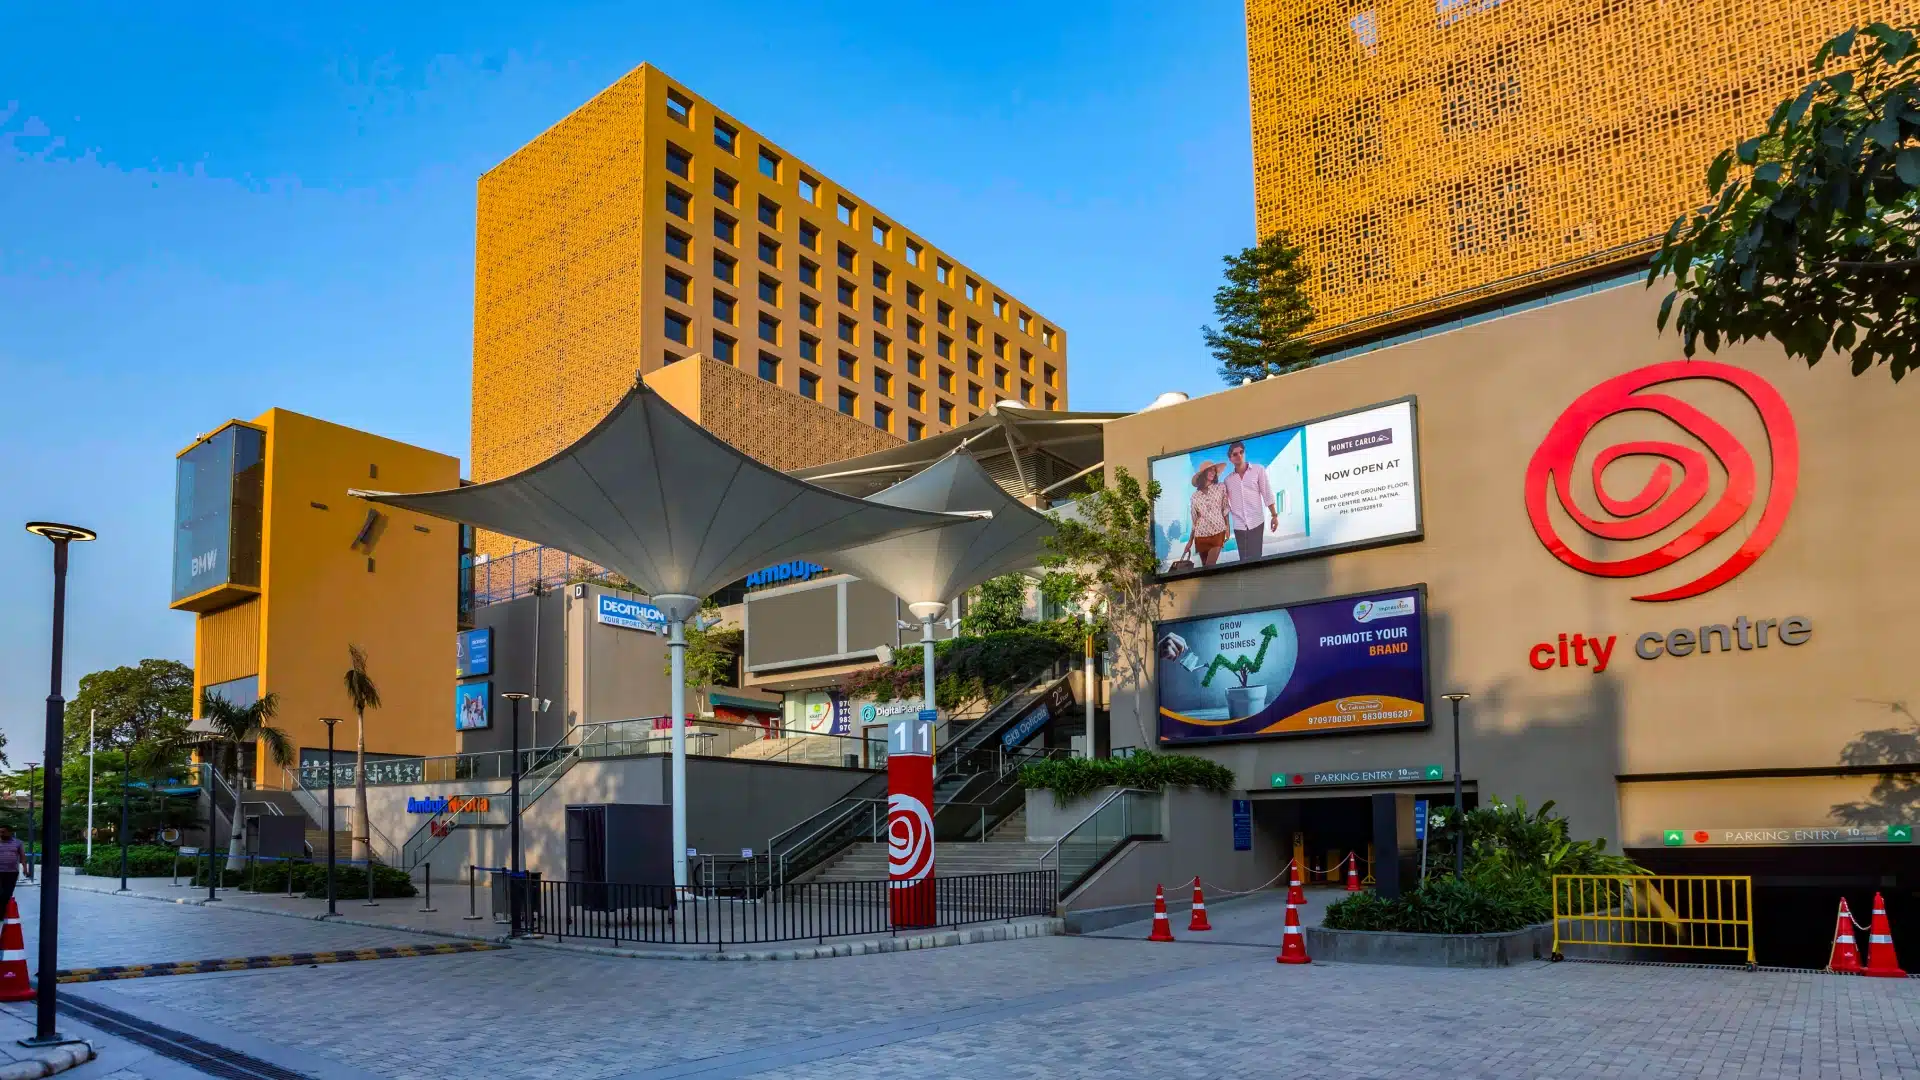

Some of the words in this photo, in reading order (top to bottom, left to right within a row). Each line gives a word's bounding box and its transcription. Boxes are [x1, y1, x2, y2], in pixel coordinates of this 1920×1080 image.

[1330, 440, 1353, 452] MONTE
[1354, 435, 1376, 447] CARLO
[1324, 469, 1350, 482] NOW
[1352, 462, 1384, 476] OPEN
[1386, 458, 1401, 470] AT
[1339, 490, 1360, 500] UPPER
[1360, 485, 1387, 495] GROUND
[1323, 502, 1337, 510] CITY
[1337, 498, 1361, 508] CENTRE
[1361, 495, 1378, 503] MALL
[191, 548, 218, 577] BMW
[575, 586, 582, 596] D
[603, 599, 665, 621] DECATHLON
[603, 615, 620, 625] YOUR
[621, 618, 645, 629] SPORTS
[1220, 621, 1242, 631] GROW
[1220, 631, 1240, 640] YOUR
[1319, 630, 1373, 648] PROMOTE
[1375, 626, 1408, 641] YOUR
[1220, 639, 1256, 650] BUSINESS
[1369, 642, 1408, 657] BRAND
[1529, 632, 1617, 673] city
[1635, 615, 1813, 660] centre
[1005, 728, 1020, 745] GKB
[1020, 708, 1047, 734] Opticals
[1314, 772, 1360, 783] PARKING
[1362, 770, 1394, 781] ENTRY
[1397, 768, 1408, 776] 10
[1724, 830, 1790, 841] PARKING
[1794, 829, 1839, 841] ENTRY
